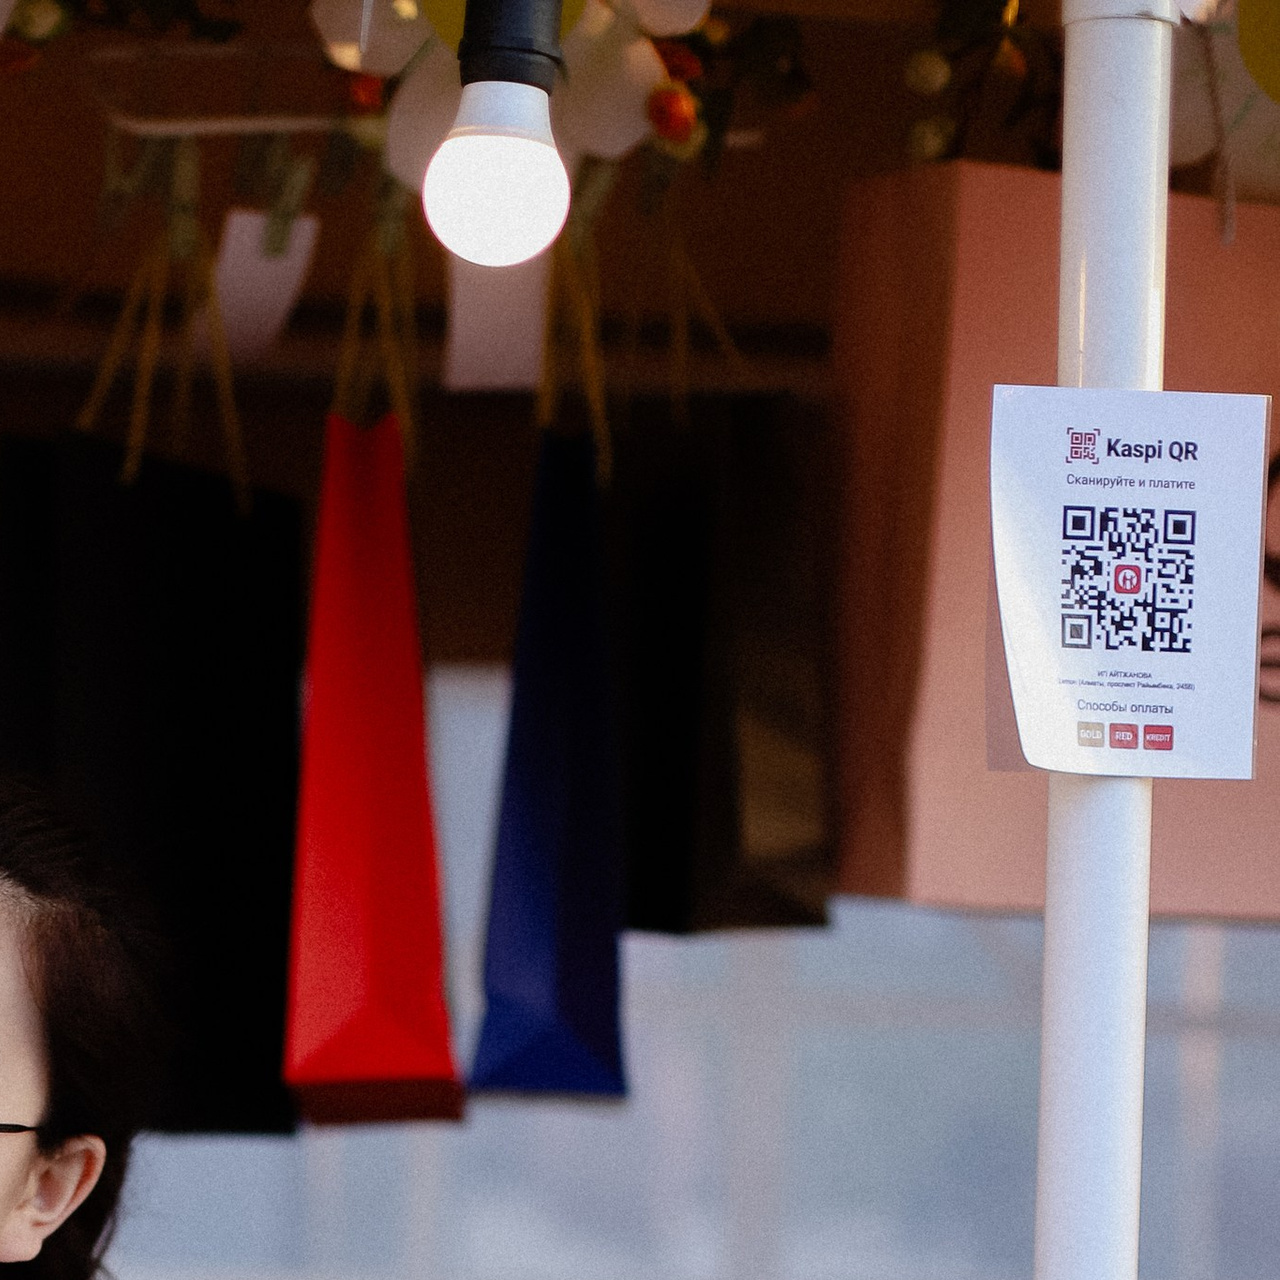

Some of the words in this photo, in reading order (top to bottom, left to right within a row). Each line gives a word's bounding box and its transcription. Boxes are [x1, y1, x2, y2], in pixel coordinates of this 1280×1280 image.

[1107, 438, 1163, 463] Kaspi
[1169, 441, 1198, 462] QR
[1066, 473, 1136, 488] Сканируйте
[1138, 479, 1146, 487] и
[1149, 479, 1195, 490] платите
[1077, 699, 1127, 712] Способы
[1130, 703, 1173, 714] оплаты
[1080, 729, 1103, 739] GOLD
[1115, 731, 1133, 741] RED
